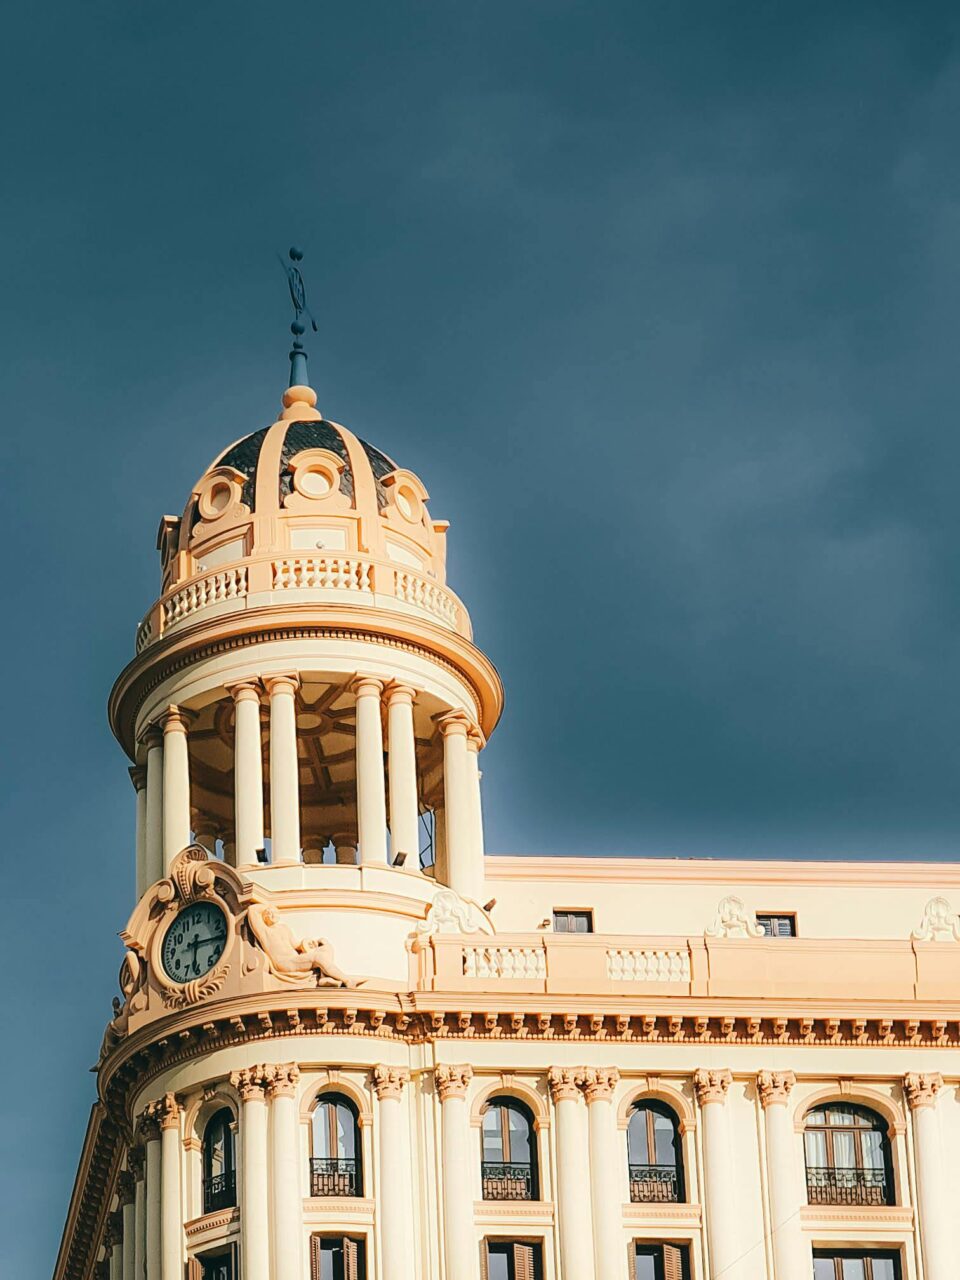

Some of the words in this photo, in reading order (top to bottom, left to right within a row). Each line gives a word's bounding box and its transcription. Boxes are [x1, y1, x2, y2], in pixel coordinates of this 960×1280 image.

[192, 912, 202, 926] 12
[207, 912, 211, 924] 1
[215, 918, 221, 931] 2
[182, 919, 190, 933] 11
[173, 933, 184, 947] 10
[170, 947, 176, 960] 9
[213, 944, 221, 956] 4
[175, 958, 181, 970] 8
[207, 955, 214, 967] 5
[184, 964, 190, 977] 7
[195, 963, 201, 976] 6
